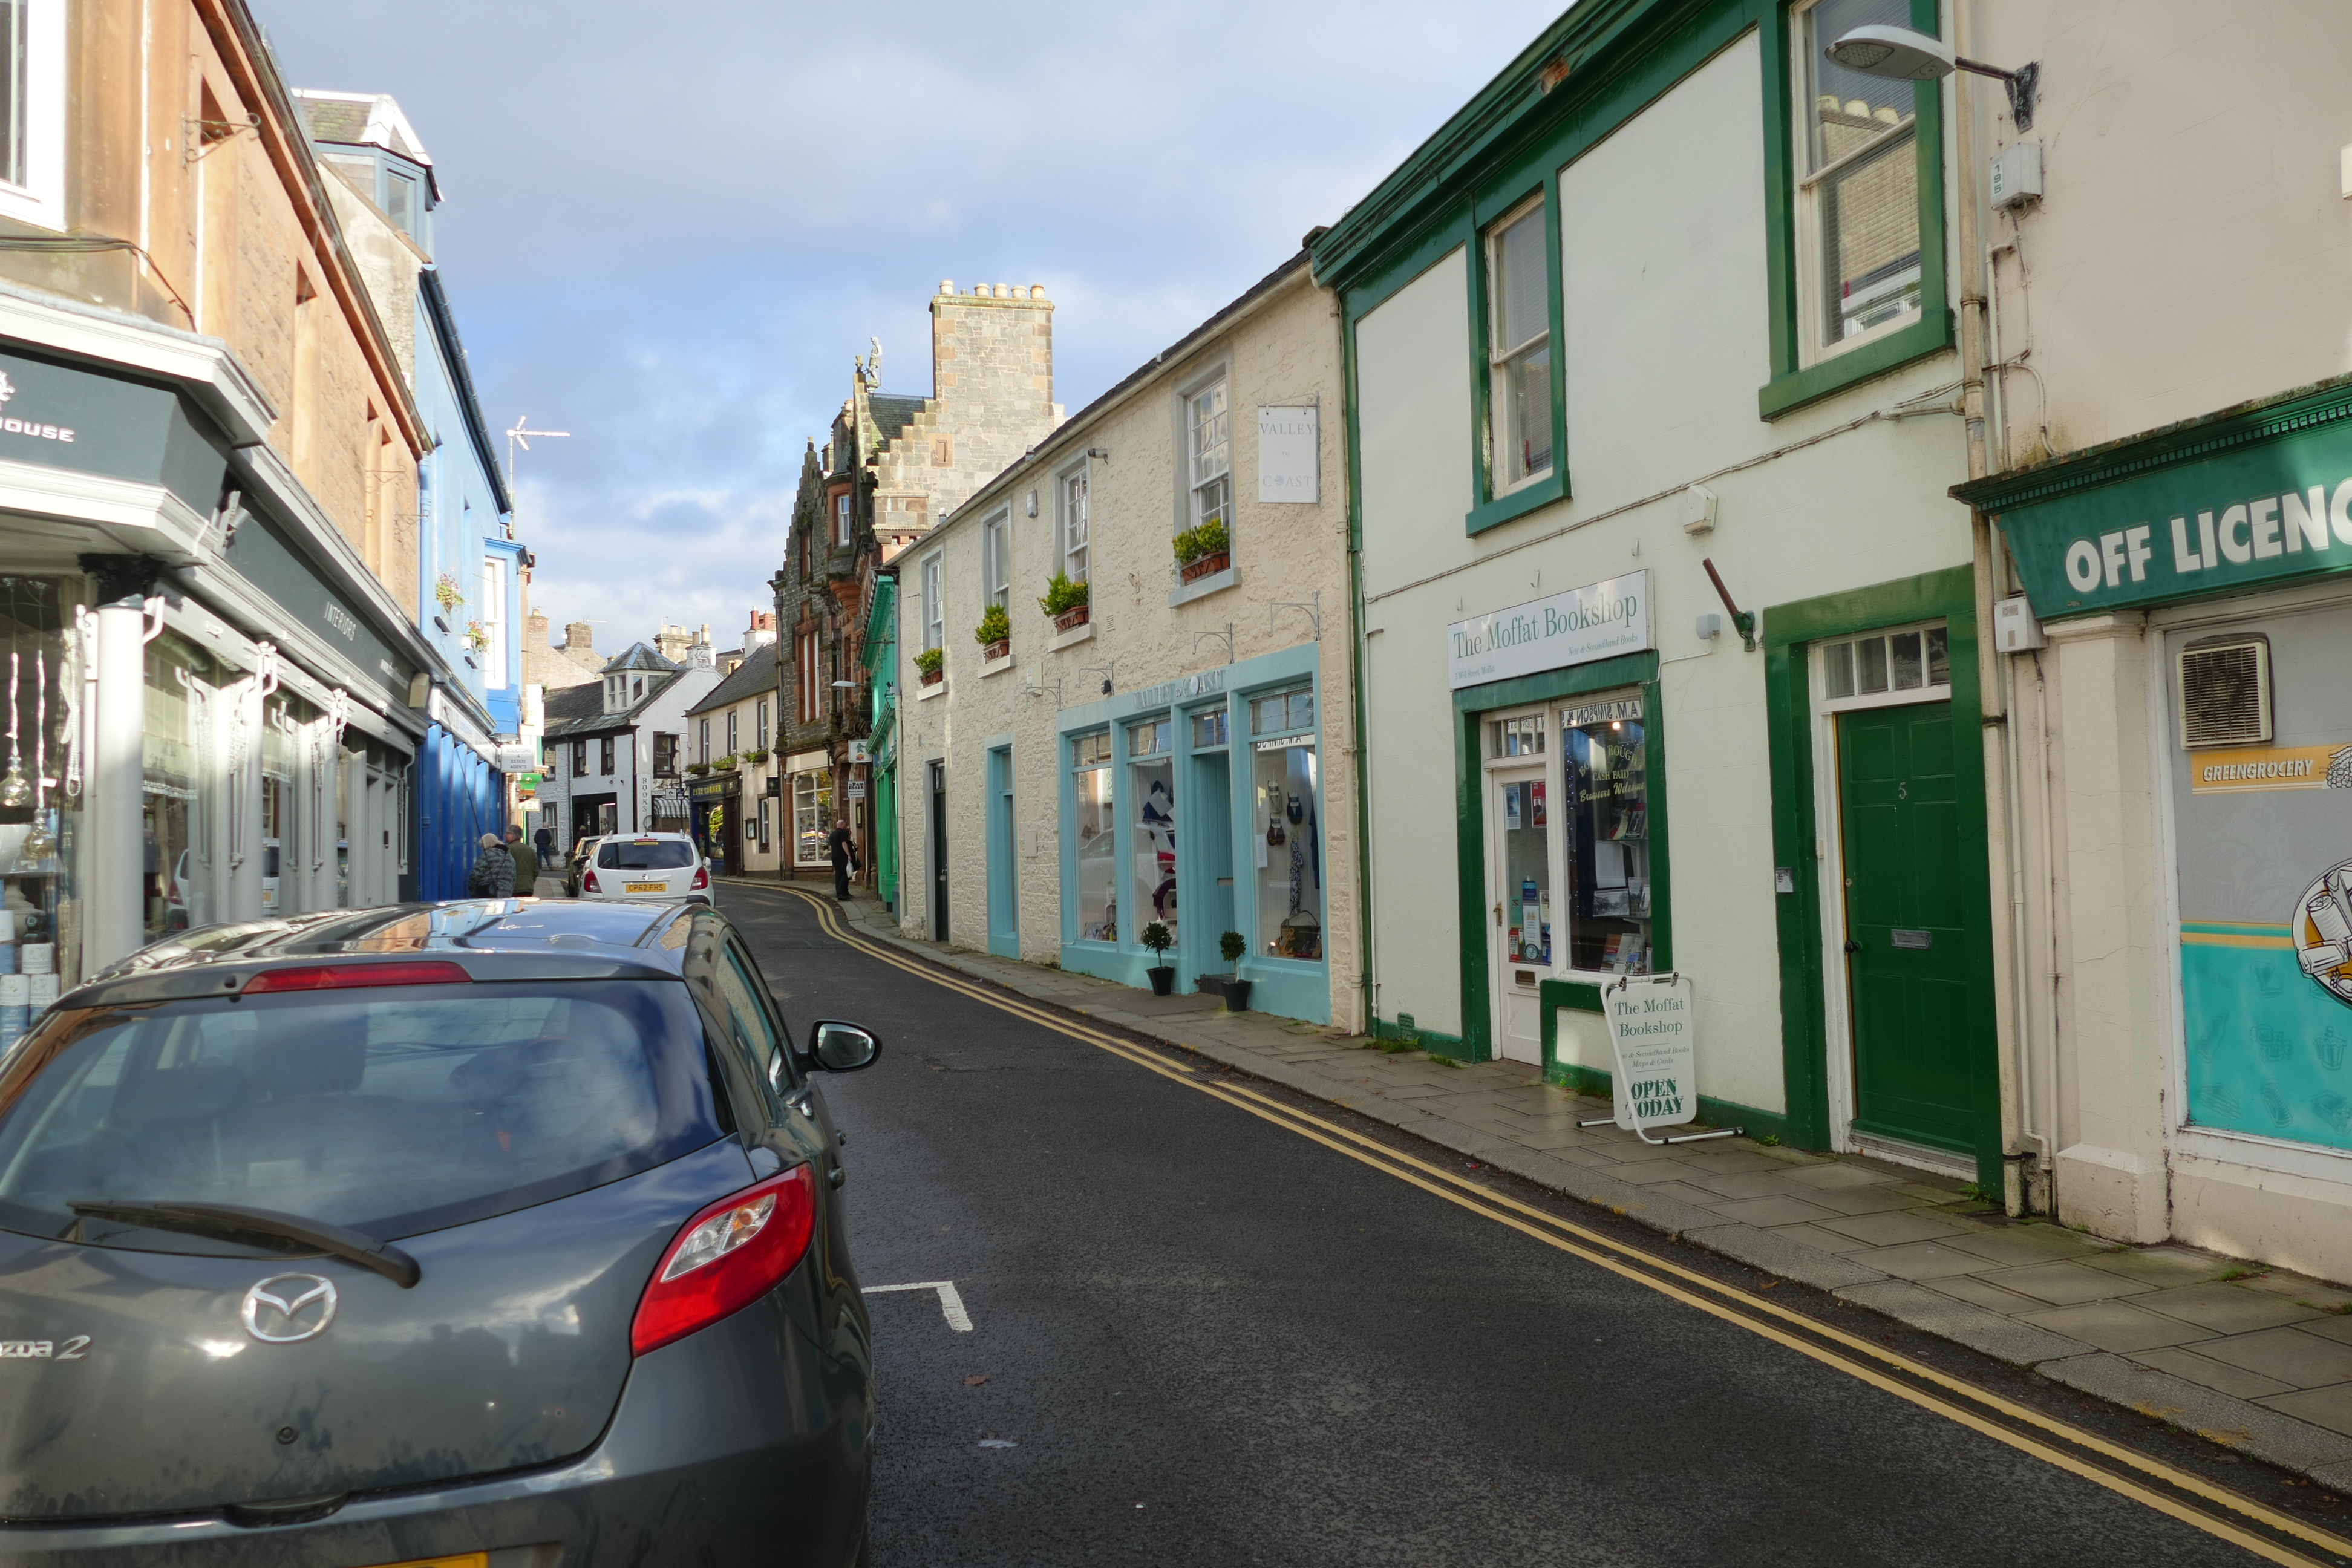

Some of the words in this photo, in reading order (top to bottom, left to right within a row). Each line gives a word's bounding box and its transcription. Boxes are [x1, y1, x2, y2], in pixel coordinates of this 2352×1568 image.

[1260, 423, 1315, 435] VALLEY
[2066, 523, 2151, 593] OFF
[324, 601, 357, 641] INTERIORS
[1454, 631, 1482, 659] The
[1486, 615, 1540, 652] Moffat
[1543, 593, 1638, 638] Bookshop
[1567, 646, 1580, 656] New
[1580, 645, 1585, 654] &
[1586, 635, 1619, 652] Secondhand
[1620, 632, 1638, 645] Books
[1458, 670, 1468, 679] Well
[1481, 666, 1495, 675] Moffat
[1134, 683, 1176, 710] VALLEY
[1592, 771, 1610, 781] CASH
[1612, 769, 1629, 780] PAID
[2203, 759, 2314, 782] GREENGROCERY
[704, 785, 722, 794] CORNER
[1579, 789, 1611, 802] Browsers
[1613, 781, 1645, 795] Welcome
[1898, 782, 1907, 799] 5
[518, 800, 539, 810] PEN
[1614, 1001, 1639, 1016] The
[1643, 997, 1685, 1013] Moffat
[1619, 1019, 1683, 1037] Bookshop
[1635, 1049, 1670, 1058] Secondhand
[1672, 1046, 1690, 1054] Books
[1632, 1059, 1648, 1068] Maps
[1656, 1056, 1674, 1065] Cards
[1631, 1077, 1677, 1100] OPEN
[55, 1334, 92, 1361] 2
